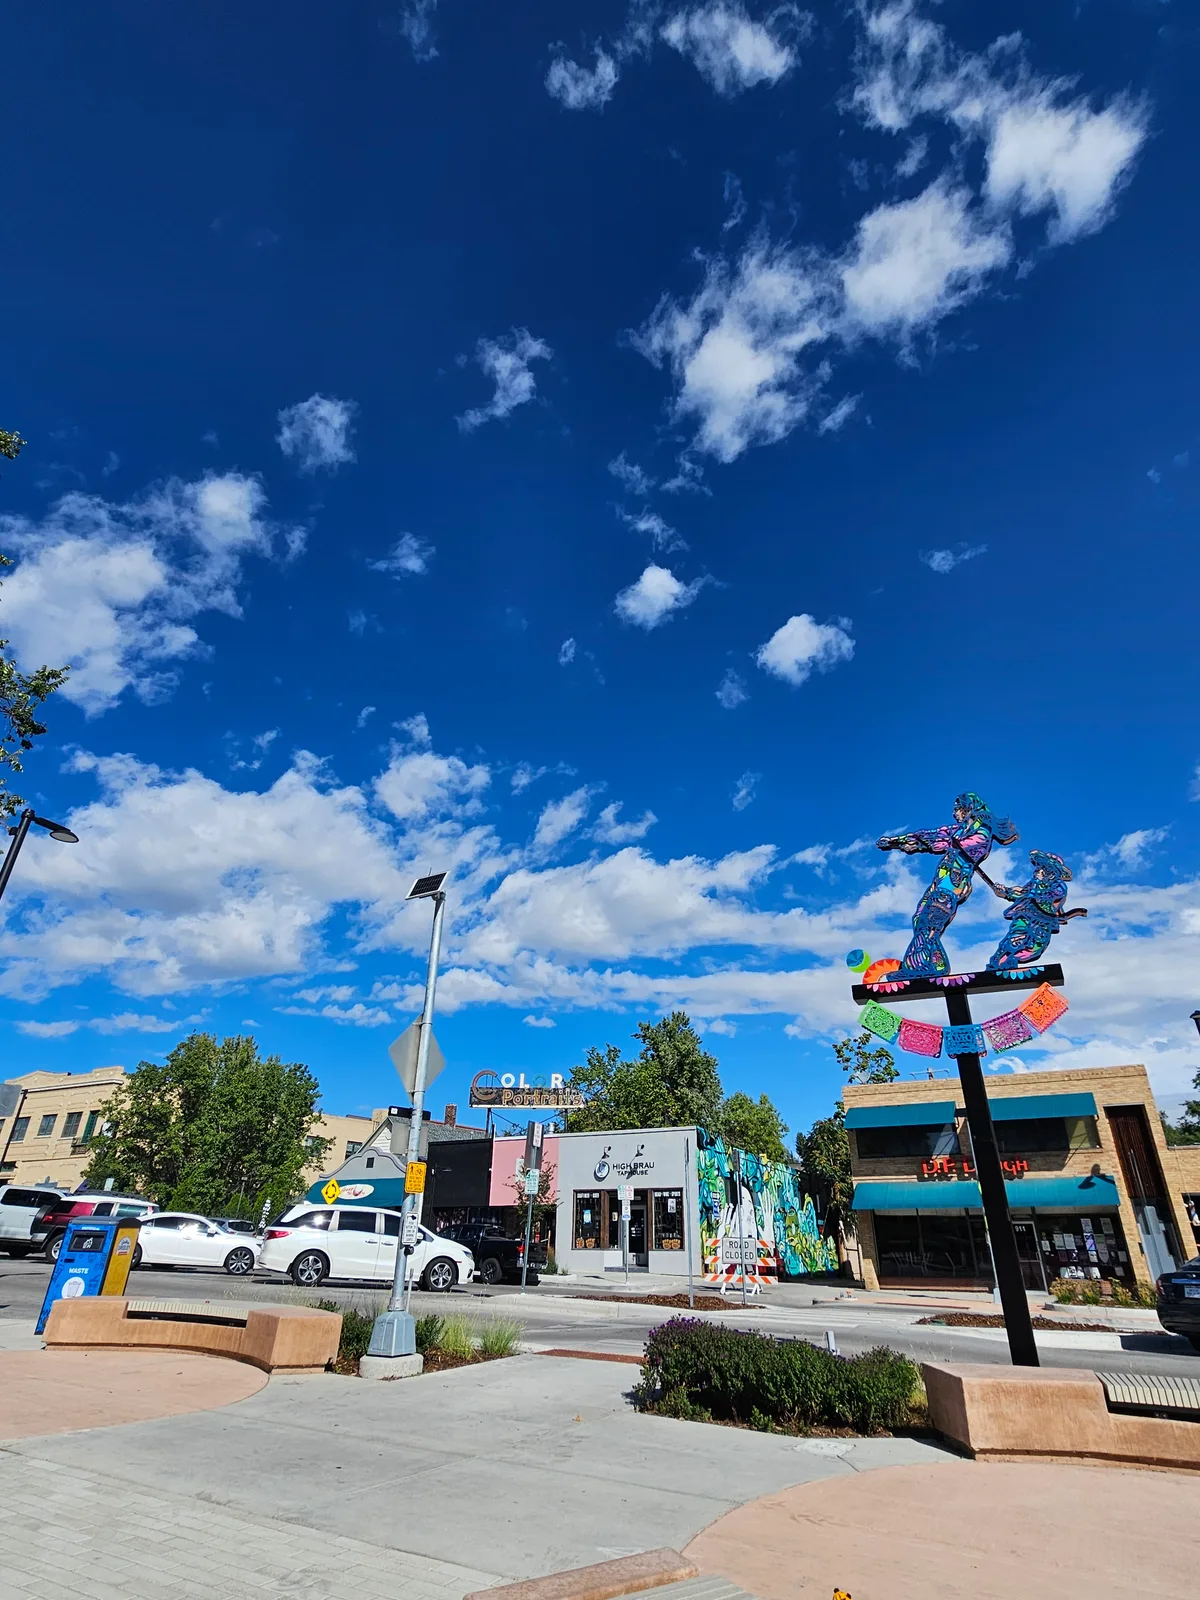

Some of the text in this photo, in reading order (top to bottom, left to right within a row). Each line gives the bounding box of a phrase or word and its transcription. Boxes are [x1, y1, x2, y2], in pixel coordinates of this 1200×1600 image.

[501, 1089, 583, 1105] Portraits
[633, 1162, 655, 1170] BRAU
[68, 1267, 90, 1275] WASTE
